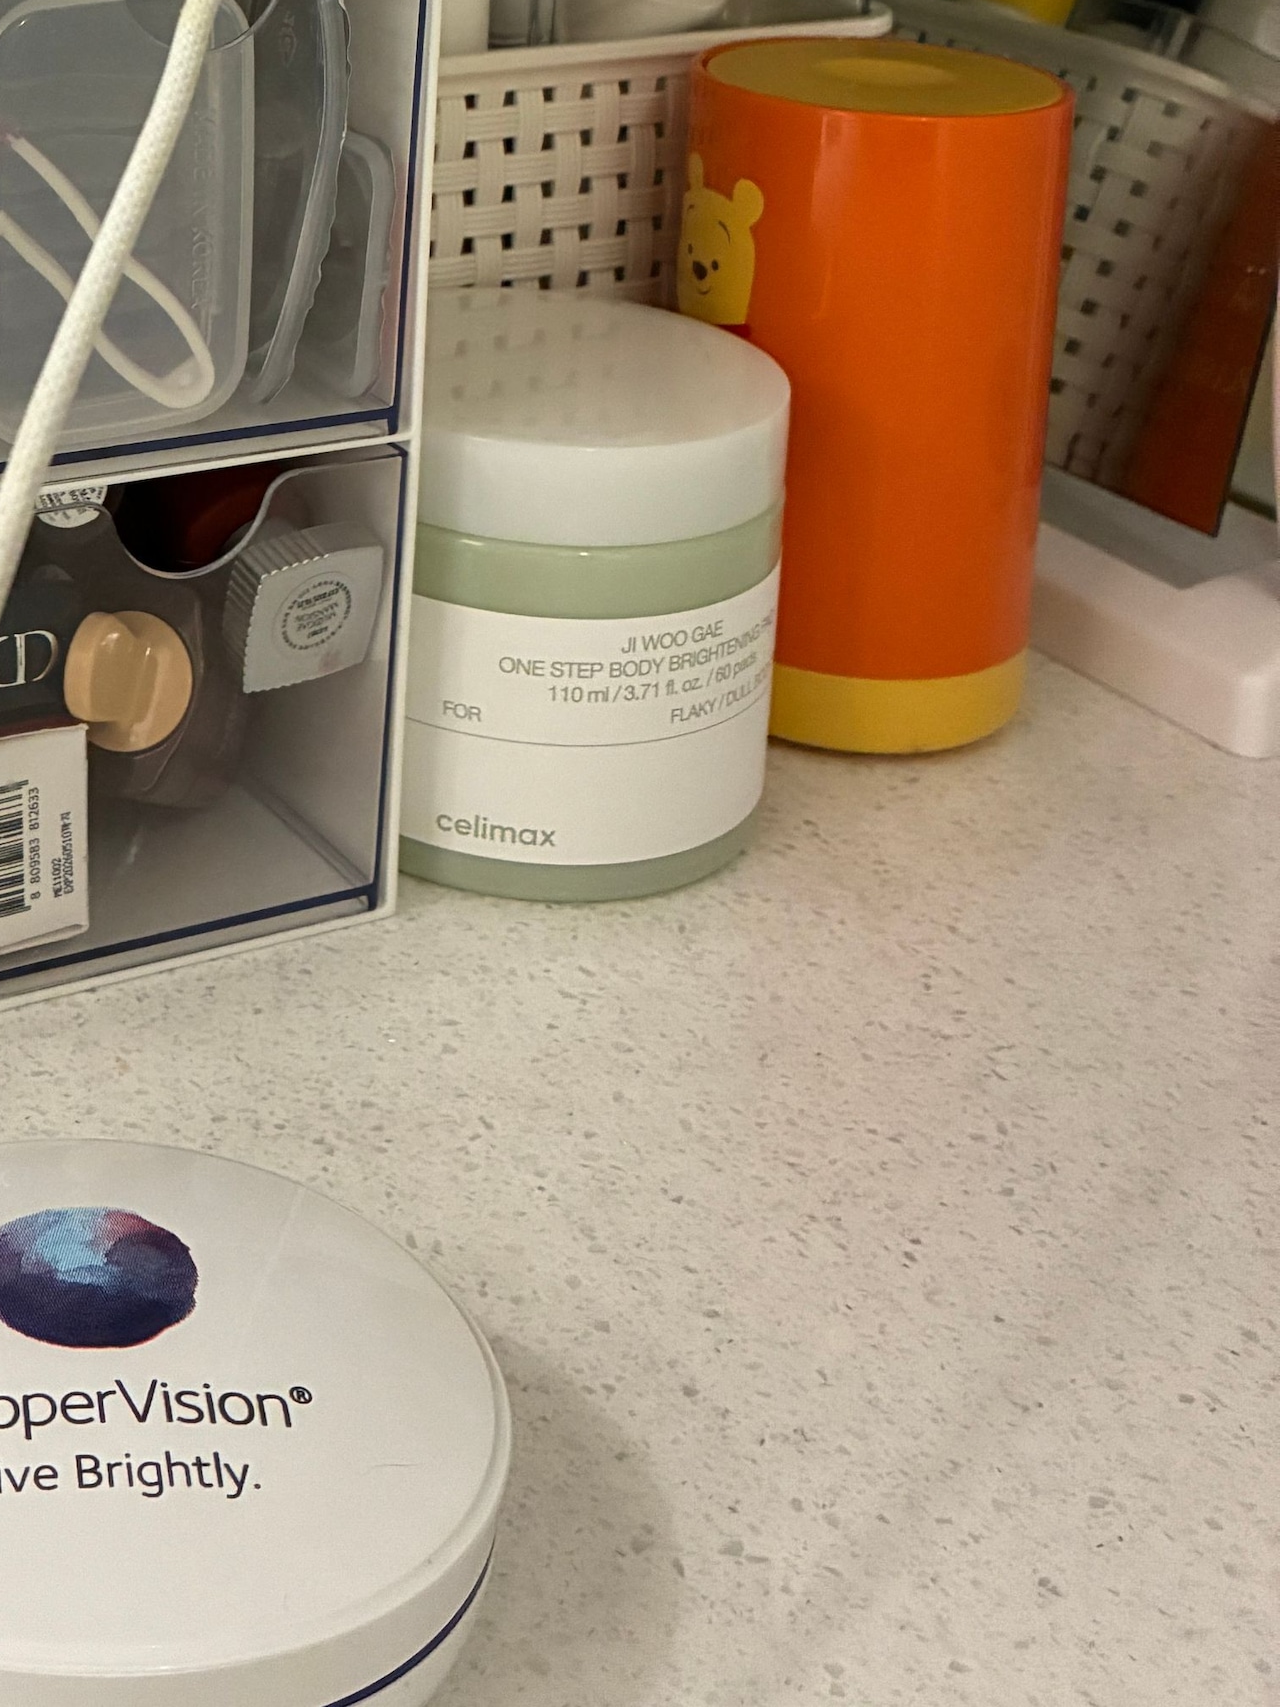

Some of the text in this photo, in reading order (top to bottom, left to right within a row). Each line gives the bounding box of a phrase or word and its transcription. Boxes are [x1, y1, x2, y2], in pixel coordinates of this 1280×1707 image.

[499, 624, 760, 679] ONE STEP BODY BRIGHTENING
[621, 620, 724, 654] JI WOO GAE
[549, 686, 583, 703] 110
[587, 686, 609, 703] ml
[623, 683, 660, 701] 3.71
[715, 663, 730, 682] 60
[442, 700, 482, 722] FOR
[671, 697, 716, 723] FLAKY
[28, 787, 40, 831] 812633
[436, 812, 557, 848] celimax
[29, 838, 41, 884] 809583
[74, 1449, 263, 1498] Brightly.
